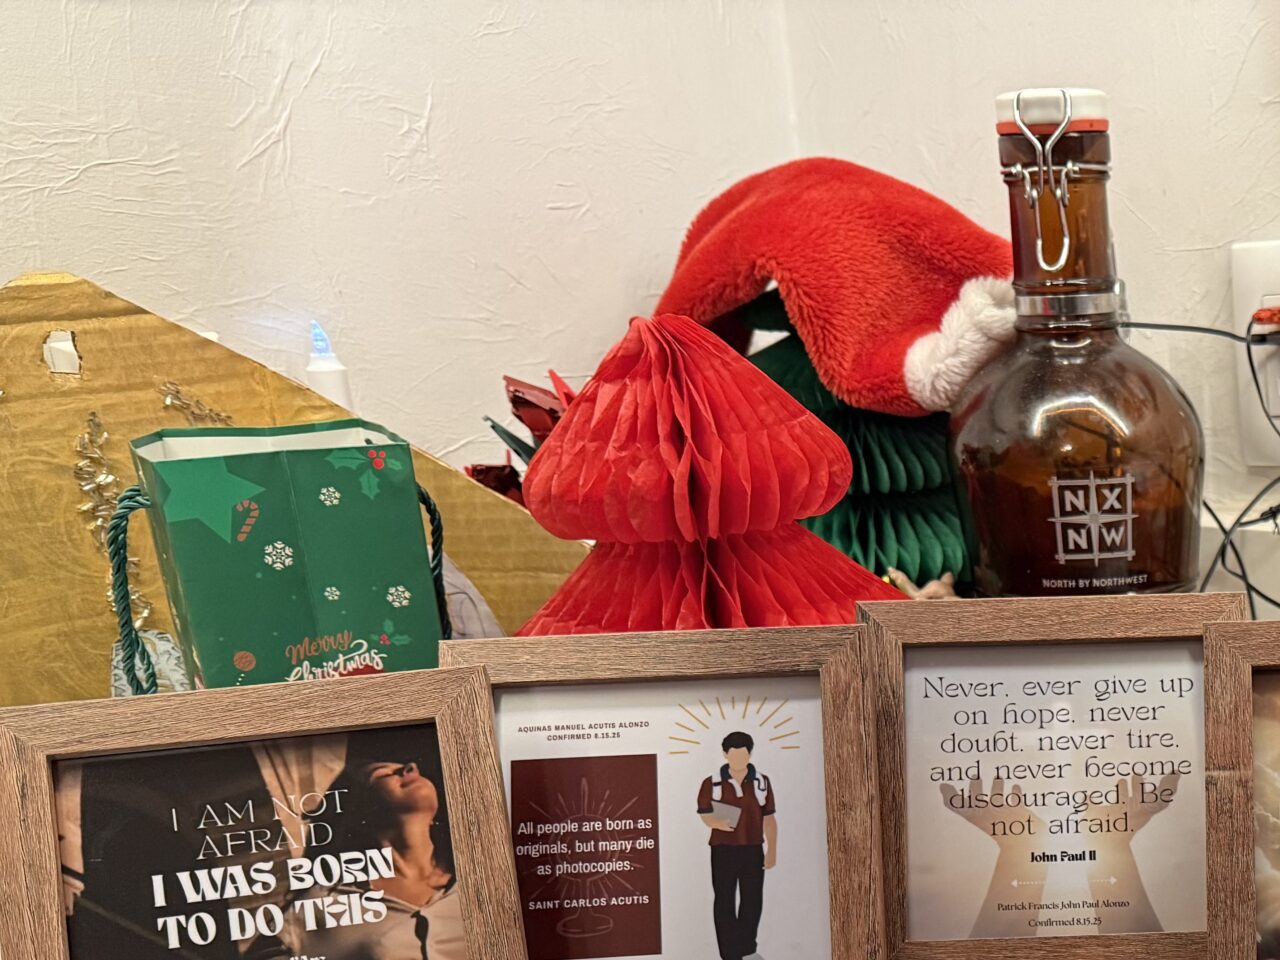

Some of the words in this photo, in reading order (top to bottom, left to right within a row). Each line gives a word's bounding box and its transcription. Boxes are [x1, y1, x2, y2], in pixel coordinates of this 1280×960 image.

[1042, 578, 1076, 588] NORTH
[1078, 579, 1091, 588] BY
[1093, 574, 1148, 588] NORTHWEST
[285, 629, 352, 665] Merry
[1022, 679, 1081, 697] ever
[1094, 675, 1147, 701] give
[1160, 677, 1194, 698] up
[954, 708, 989, 726] on
[1089, 705, 1165, 722] never
[518, 725, 552, 733] AQUINAS
[554, 723, 585, 731] MANUEL
[588, 722, 616, 730] ACUTIS
[547, 733, 592, 742] CONFIRMED
[1038, 733, 1115, 751] never
[930, 760, 980, 782] and
[995, 763, 1072, 780] never
[1085, 756, 1191, 778] become
[950, 785, 1125, 812] discouraged.
[1140, 782, 1174, 804] Be
[172, 808, 178, 832] I
[197, 800, 255, 829] AM
[272, 789, 348, 821] NOT
[518, 822, 533, 835] All
[537, 820, 578, 836] people
[582, 821, 602, 832] are
[606, 818, 634, 831] born
[638, 818, 652, 829] as
[990, 816, 1036, 836] not
[1049, 812, 1134, 834] afraid.
[196, 822, 333, 860] AFRAID
[516, 841, 572, 857] originals,
[575, 840, 595, 852] but
[599, 840, 632, 852] many
[636, 837, 655, 849] die
[1031, 852, 1057, 863] John
[1060, 850, 1086, 862] Paul
[1089, 850, 1097, 861] II
[151, 874, 167, 907] I
[176, 861, 276, 904] WAS
[286, 847, 396, 891] BORN
[537, 865, 551, 876] as
[556, 859, 634, 877] photocopies.
[528, 901, 560, 910] SAINT
[564, 898, 607, 908] CARLOS
[610, 895, 650, 905] ACUTIS
[997, 902, 1027, 911] Patrick
[1028, 901, 1059, 911] Francis
[1059, 901, 1081, 910] John
[1082, 900, 1099, 909] Paul
[1099, 899, 1130, 908] Alonzo
[157, 911, 217, 950] TO
[227, 904, 284, 941] DO
[294, 889, 388, 931] THIS
[1028, 918, 1075, 928] Confirmed
[1076, 917, 1102, 926] 8.15.25
